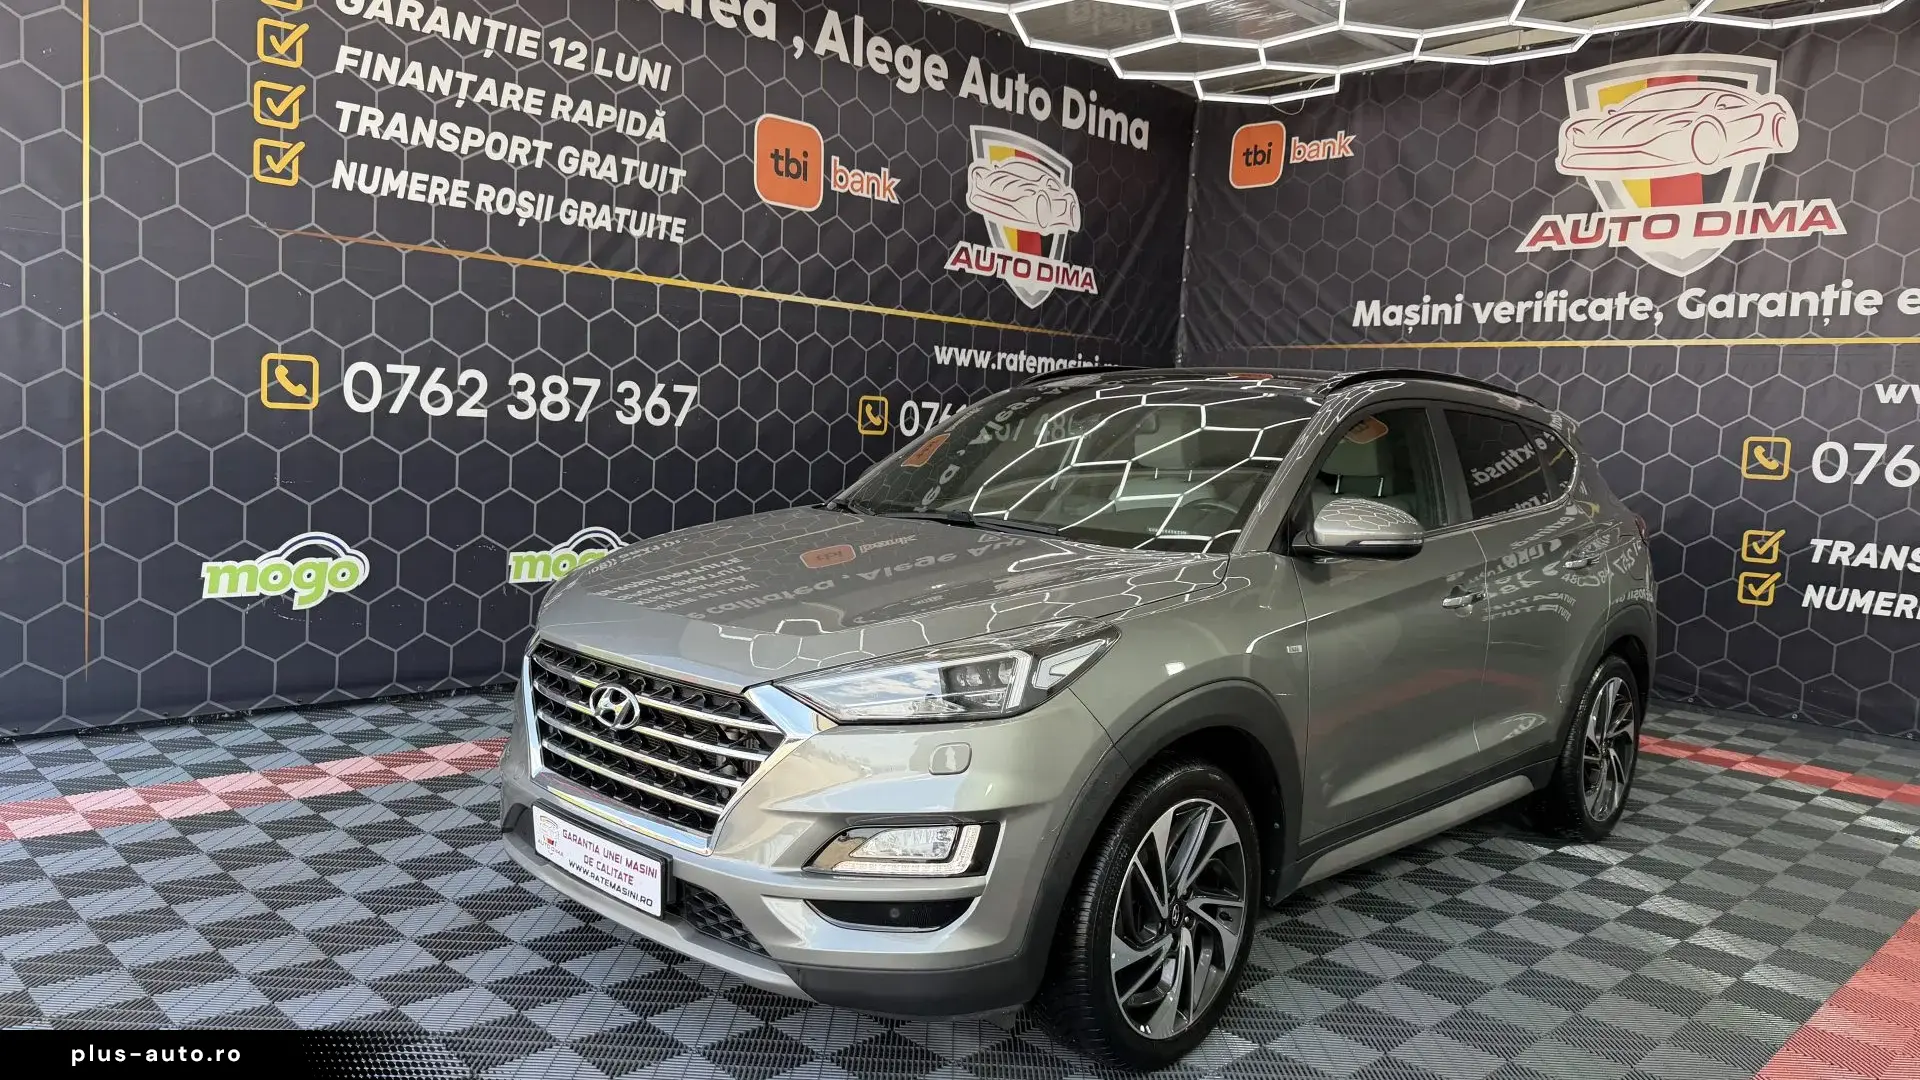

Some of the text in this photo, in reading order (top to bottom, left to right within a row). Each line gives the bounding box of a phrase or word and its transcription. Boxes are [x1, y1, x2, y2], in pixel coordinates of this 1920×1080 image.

[335, 0, 672, 92] GARANȚIE 12 LUNI
[334, 45, 669, 143] FINANȚARE RAPIDĂ
[814, 10, 948, 93] Alege
[958, 56, 1052, 122] Auto
[1062, 86, 1151, 151] Dima
[334, 101, 686, 195] TRANSPORT GRATUIT
[769, 147, 899, 203] tbi bank
[1241, 131, 1355, 168] tbi bank
[332, 160, 686, 244] NUMERE ROȘII GRATUITE
[1525, 204, 1837, 248] AUTO DIMA
[950, 245, 1096, 291] AUTO DIMA
[1352, 294, 1464, 334] Mașini
[1472, 287, 1666, 327] verificate,
[1676, 279, 1883, 328] Garanție
[342, 361, 699, 428] 0762 387 367
[1811, 440, 1920, 489] 076
[204, 557, 364, 610] mogo
[1801, 584, 1920, 621] NUMER
[562, 829, 658, 880] GARANTIA UNEI MASINI
[583, 854, 634, 886] DE CALITATE
